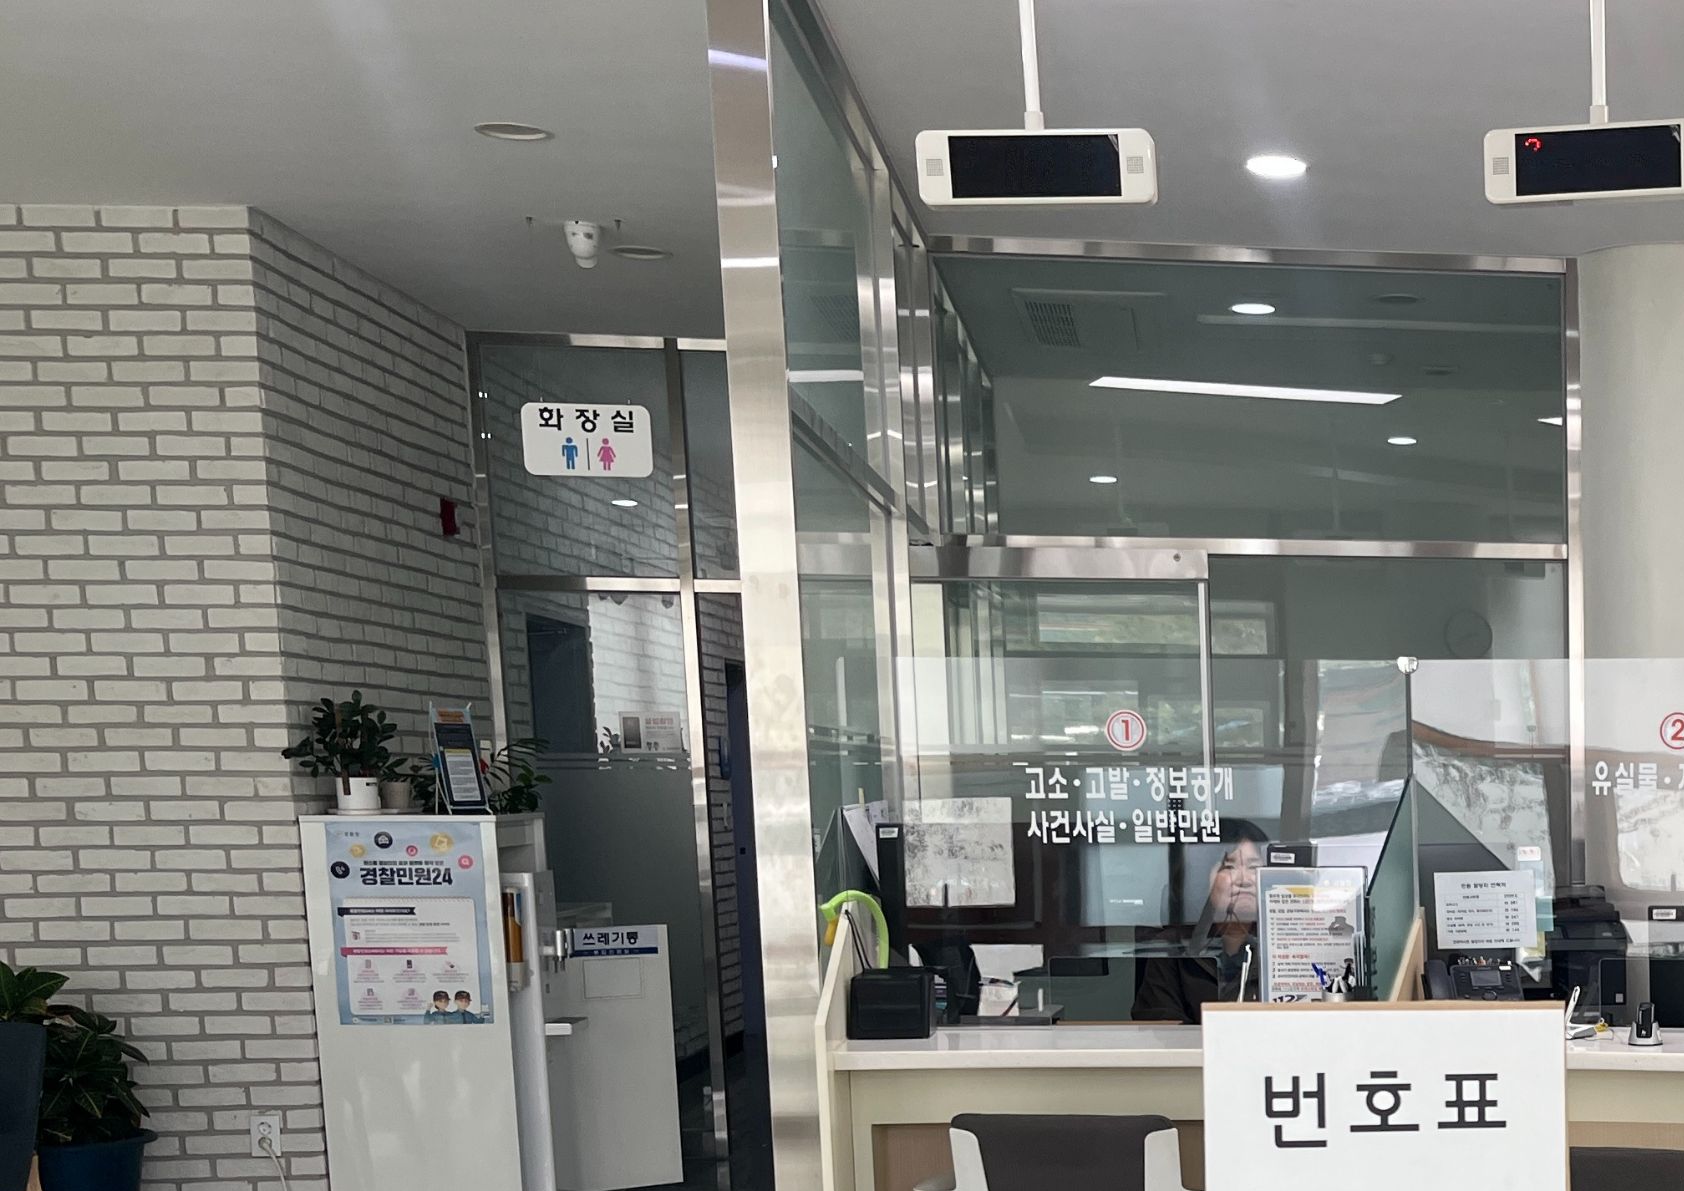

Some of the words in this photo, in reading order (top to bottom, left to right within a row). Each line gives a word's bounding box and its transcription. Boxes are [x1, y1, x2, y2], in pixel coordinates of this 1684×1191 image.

[538, 406, 635, 433] 화장실
[360, 867, 453, 886] 경찰민원24
[582, 931, 638, 945] 쓰레기통
[1264, 1071, 1507, 1148] 번호표
